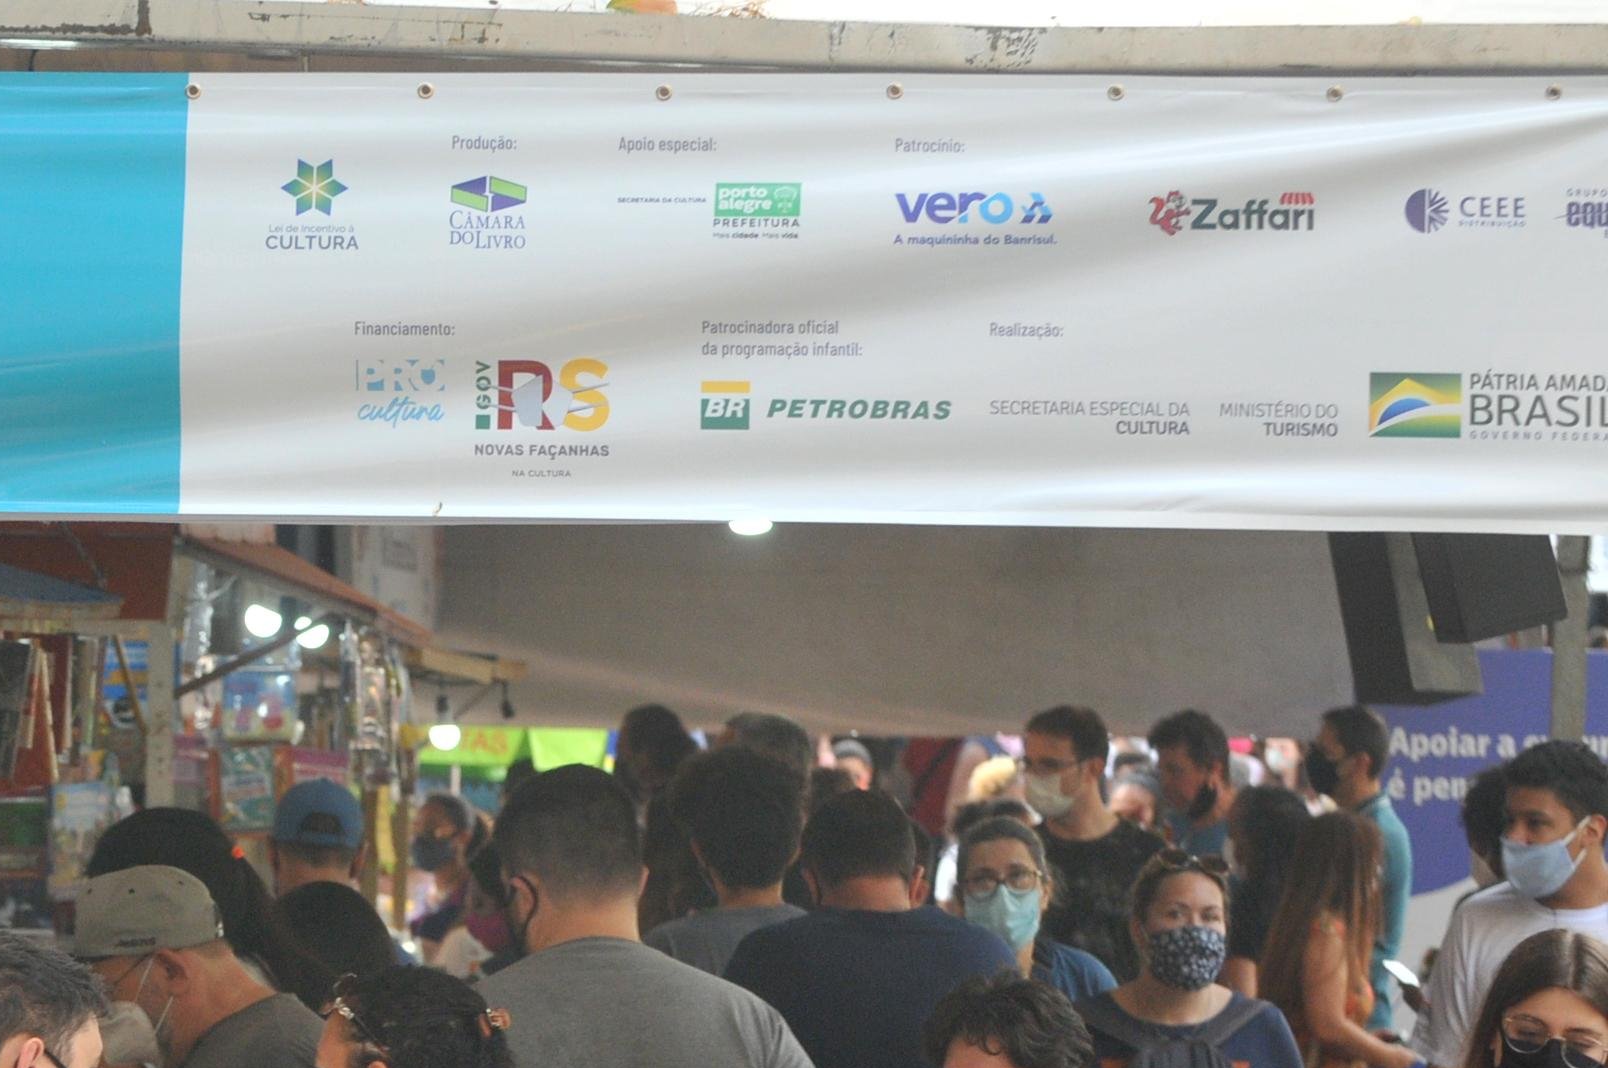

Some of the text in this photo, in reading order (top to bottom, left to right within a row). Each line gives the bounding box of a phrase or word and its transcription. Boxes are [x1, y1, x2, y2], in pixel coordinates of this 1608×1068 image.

[451, 135, 518, 153] Produção:
[618, 137, 717, 154] Apoio especial:
[894, 138, 966, 153] Patrocínio:
[718, 185, 768, 201] porto
[717, 197, 772, 215] alegre
[894, 191, 1014, 225] vero
[1190, 198, 1315, 231] Zaffari
[1458, 196, 1527, 218] CEEE
[268, 223, 283, 233] Lei
[285, 223, 299, 233] de
[300, 223, 346, 233] Incentivo
[449, 210, 526, 229] CÂMARA
[712, 218, 800, 229] PREFEITURA
[264, 235, 360, 250] CULTURA
[893, 235, 904, 245] A
[907, 234, 980, 247] maquininha
[983, 234, 1000, 245] do
[353, 321, 456, 336] Financiamento:
[701, 320, 840, 335] Patrocinadora oficial
[989, 322, 1064, 340] Realização:
[701, 341, 863, 359] da programação infantil:
[1469, 368, 1608, 391] PÁTRIA AMAD
[497, 357, 610, 432] RS
[357, 396, 445, 428] cultura
[703, 398, 747, 419] BR
[765, 398, 953, 420] PETROBRAS
[989, 400, 1191, 418] SECRETARIA ESPECIAL DA
[1219, 400, 1338, 419] MINISTÉRIO DO
[1469, 393, 1608, 428] BRASIL
[1116, 420, 1190, 436] CULTURA
[1264, 421, 1338, 437] TURISMO
[1469, 430, 1542, 441] GOVERNO
[474, 444, 610, 460] NOVAS FAÇANHAS
[511, 469, 572, 478] NA CULTURA
[1389, 725, 1491, 763] Apoiar
[1496, 733, 1517, 759] a
[1387, 766, 1406, 799] é
